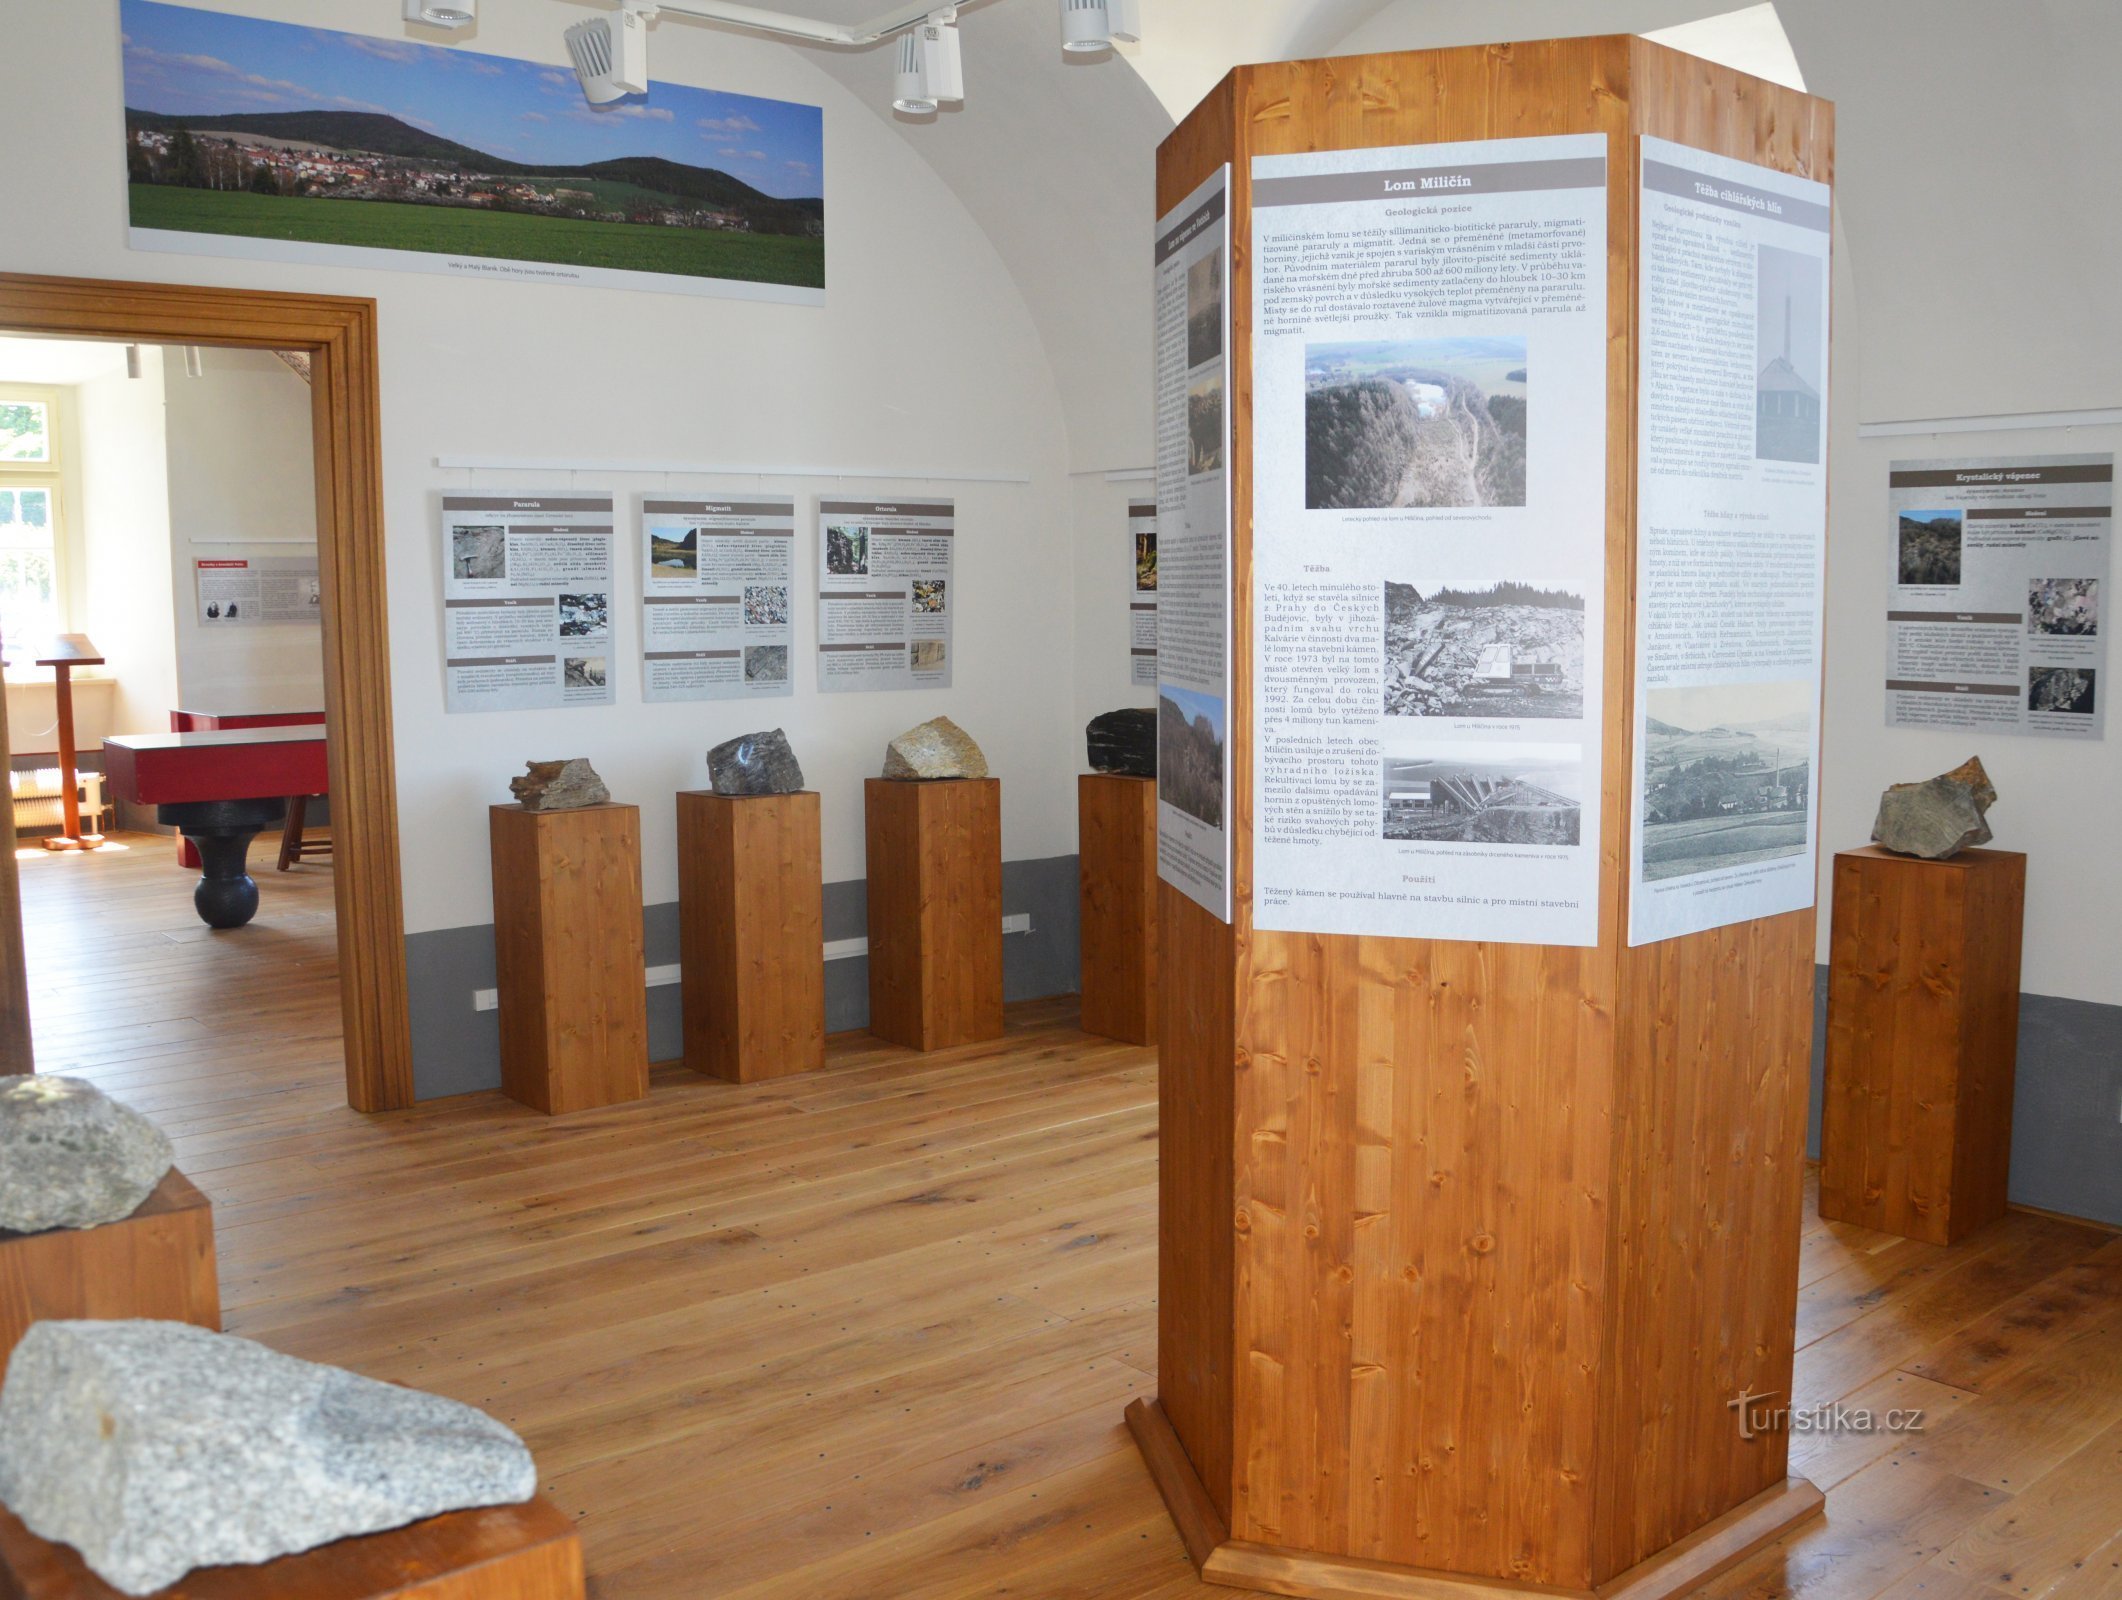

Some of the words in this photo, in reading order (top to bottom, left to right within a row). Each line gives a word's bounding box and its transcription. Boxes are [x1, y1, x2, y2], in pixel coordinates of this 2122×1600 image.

[1384, 180, 1416, 192] Lom
[1420, 175, 1472, 190] Miličín
[1695, 182, 1719, 199] Těžba
[1720, 189, 1765, 210] cihlářských
[1767, 200, 1782, 214] hlín
[1385, 206, 1437, 218] Geologická
[1441, 204, 1472, 215] pozice
[1327, 231, 1350, 239] lomu
[1363, 228, 1387, 238] těžily
[1498, 219, 1541, 234] pararuly,
[1544, 217, 1586, 231] migmati-
[1302, 240, 1340, 254] pararuly
[1353, 237, 1395, 250] migmatit.
[1263, 255, 1300, 267] horniny,
[1301, 251, 1330, 264] jejichž
[1331, 250, 1355, 259] vznik
[1356, 251, 1364, 262] je
[1366, 248, 1396, 262] spojen
[1561, 241, 1586, 251] prvo-
[1263, 265, 1280, 274] hor.
[1384, 257, 1418, 271] pararul
[1421, 255, 1440, 269] byly
[1510, 252, 1559, 264] sedimenty
[1264, 324, 1305, 337] migmatit.
[1956, 473, 2003, 482] Krystalický
[2006, 472, 2040, 481] vápenec
[1283, 594, 1304, 603] když
[1318, 593, 1349, 602] stavěla
[1351, 594, 1380, 602] silnice
[1276, 602, 1307, 614] Prahy
[1314, 604, 1326, 612] do
[1333, 602, 1380, 614] Českých
[1264, 612, 1309, 625] Budějovic,
[1315, 614, 1333, 624] byly
[1310, 622, 1342, 632] svahu
[1348, 622, 1380, 633] vrchu
[1308, 635, 1342, 643] činnosti
[1344, 635, 1360, 643] dva
[1273, 644, 1294, 655] lomy
[1297, 655, 1318, 663] 1973
[1322, 655, 1335, 665] byl
[1327, 663, 1350, 675] velký
[1354, 666, 1370, 674] lom
[1328, 736, 1353, 745] letech
[1358, 737, 1379, 746] obec
[1294, 746, 1324, 756] usiluje
[1365, 748, 1380, 756] do-
[1308, 755, 1345, 766] prostoru
[1351, 757, 1379, 766] tohoto
[1335, 767, 1378, 776] ložiska.
[1314, 777, 1337, 785] lomu
[1340, 777, 1351, 787] by
[1402, 874, 1436, 884] Použití
[1264, 887, 1294, 898] Těžený
[1378, 892, 1407, 901] hlavně
[1424, 895, 1454, 903] stavbu
[1456, 896, 1480, 904] silnic
[1492, 899, 1506, 907] pro
